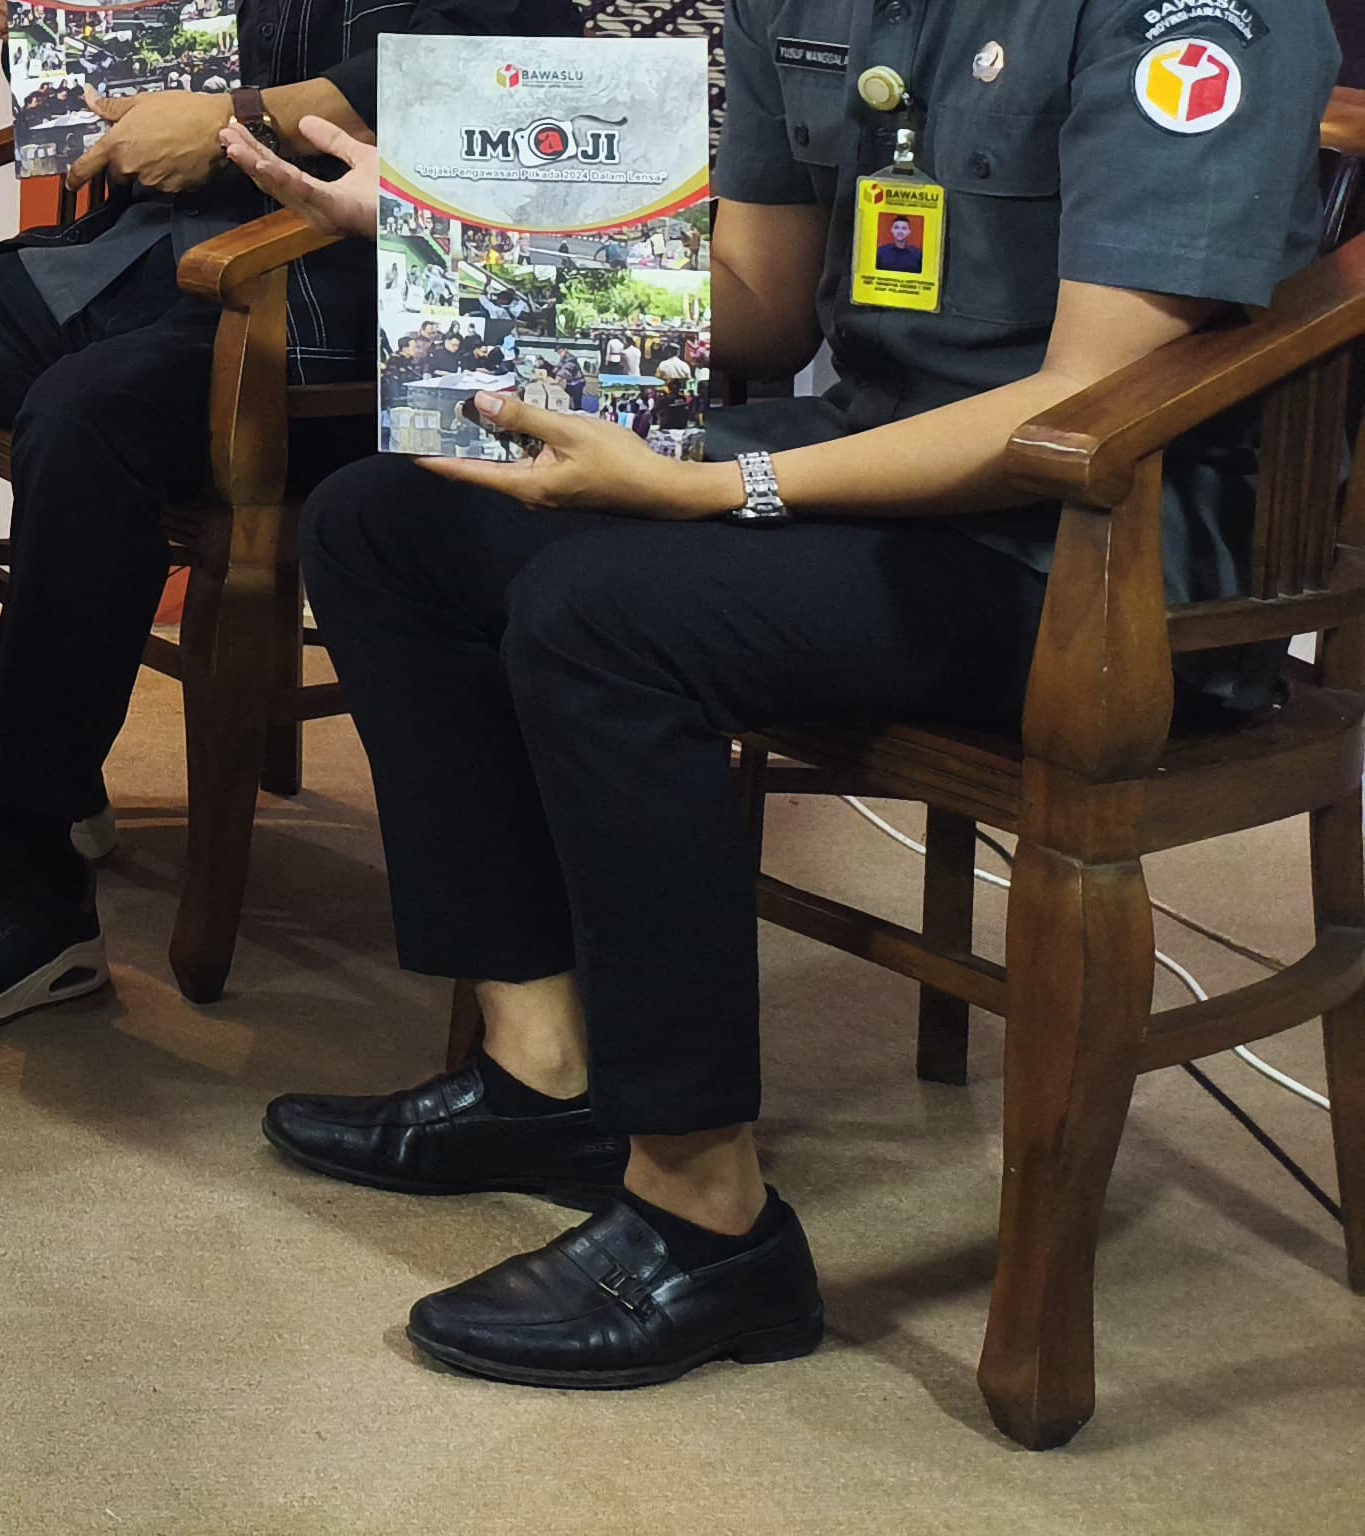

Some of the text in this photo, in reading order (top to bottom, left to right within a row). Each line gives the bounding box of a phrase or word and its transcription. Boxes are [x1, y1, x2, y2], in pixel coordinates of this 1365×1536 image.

[1189, 7, 1223, 18] JAWA
[522, 70, 584, 81] BAWASLU
[886, 189, 939, 202] BAWASLU
